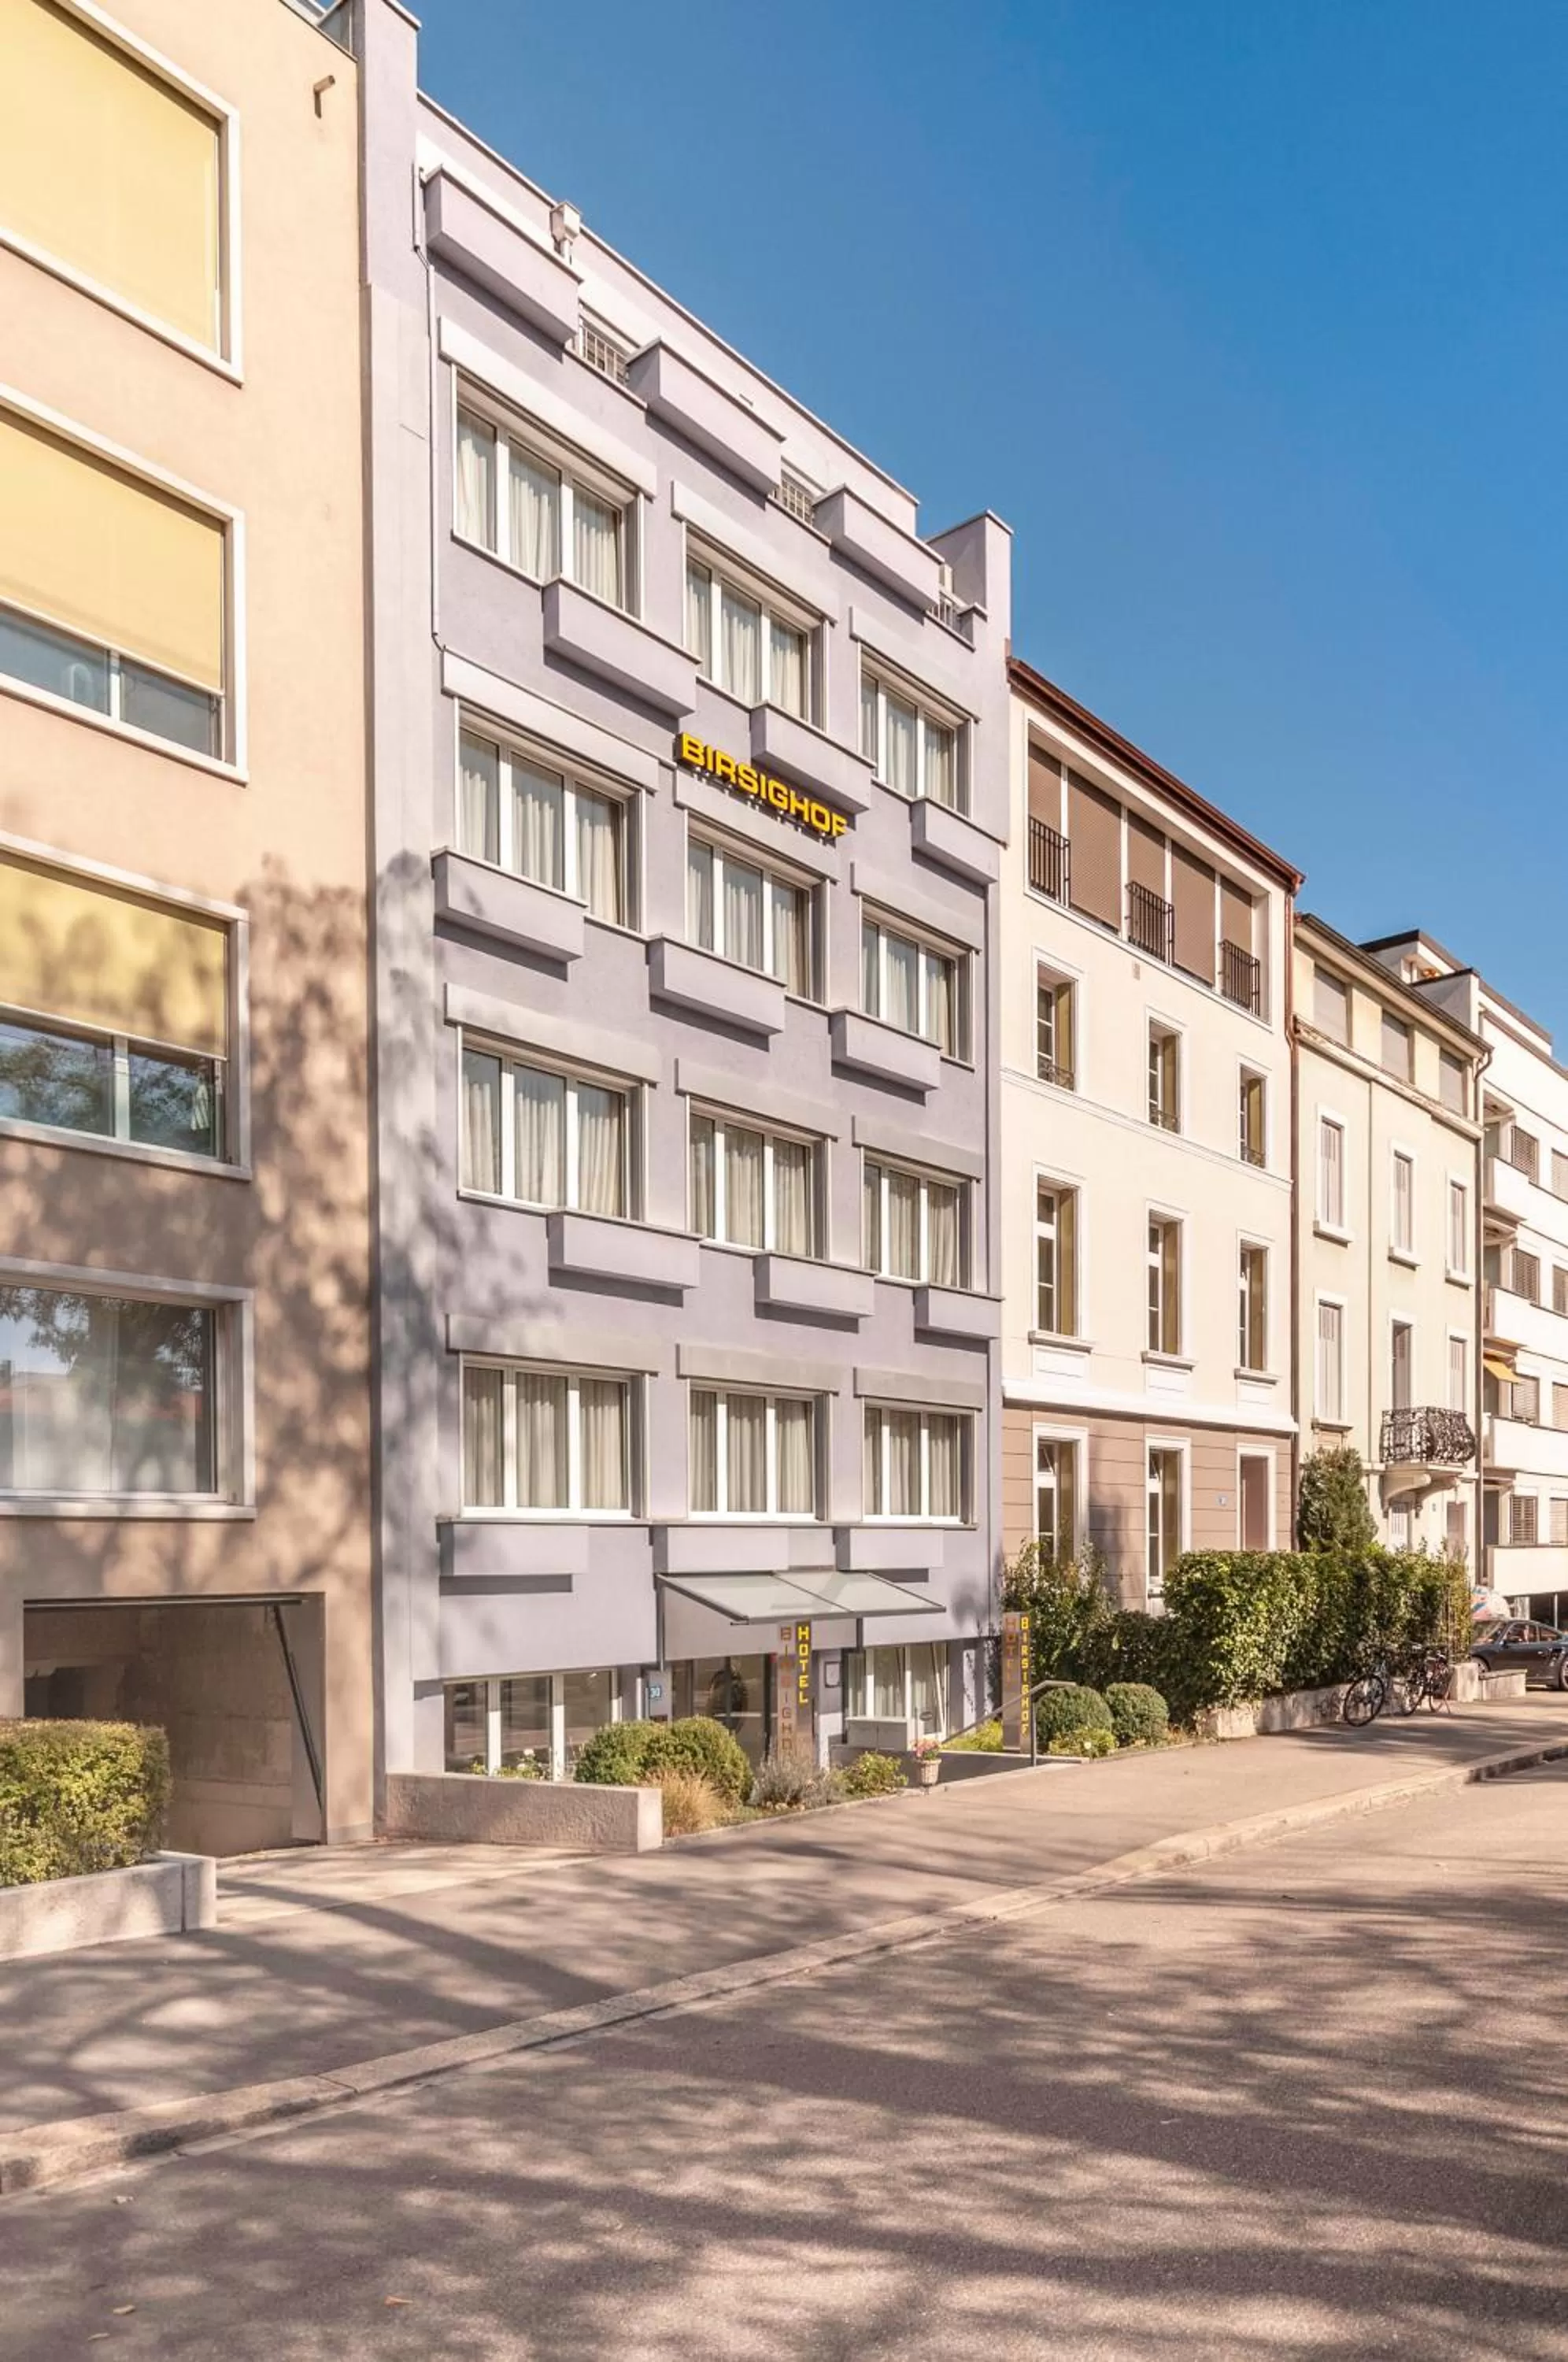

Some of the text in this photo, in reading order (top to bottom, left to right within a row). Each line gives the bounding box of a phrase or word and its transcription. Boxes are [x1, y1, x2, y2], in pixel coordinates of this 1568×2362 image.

[680, 732, 849, 838] BIRSIGHOF
[797, 1626, 810, 1704] HOTEL
[1021, 1616, 1030, 1737] BIRSIGHOF
